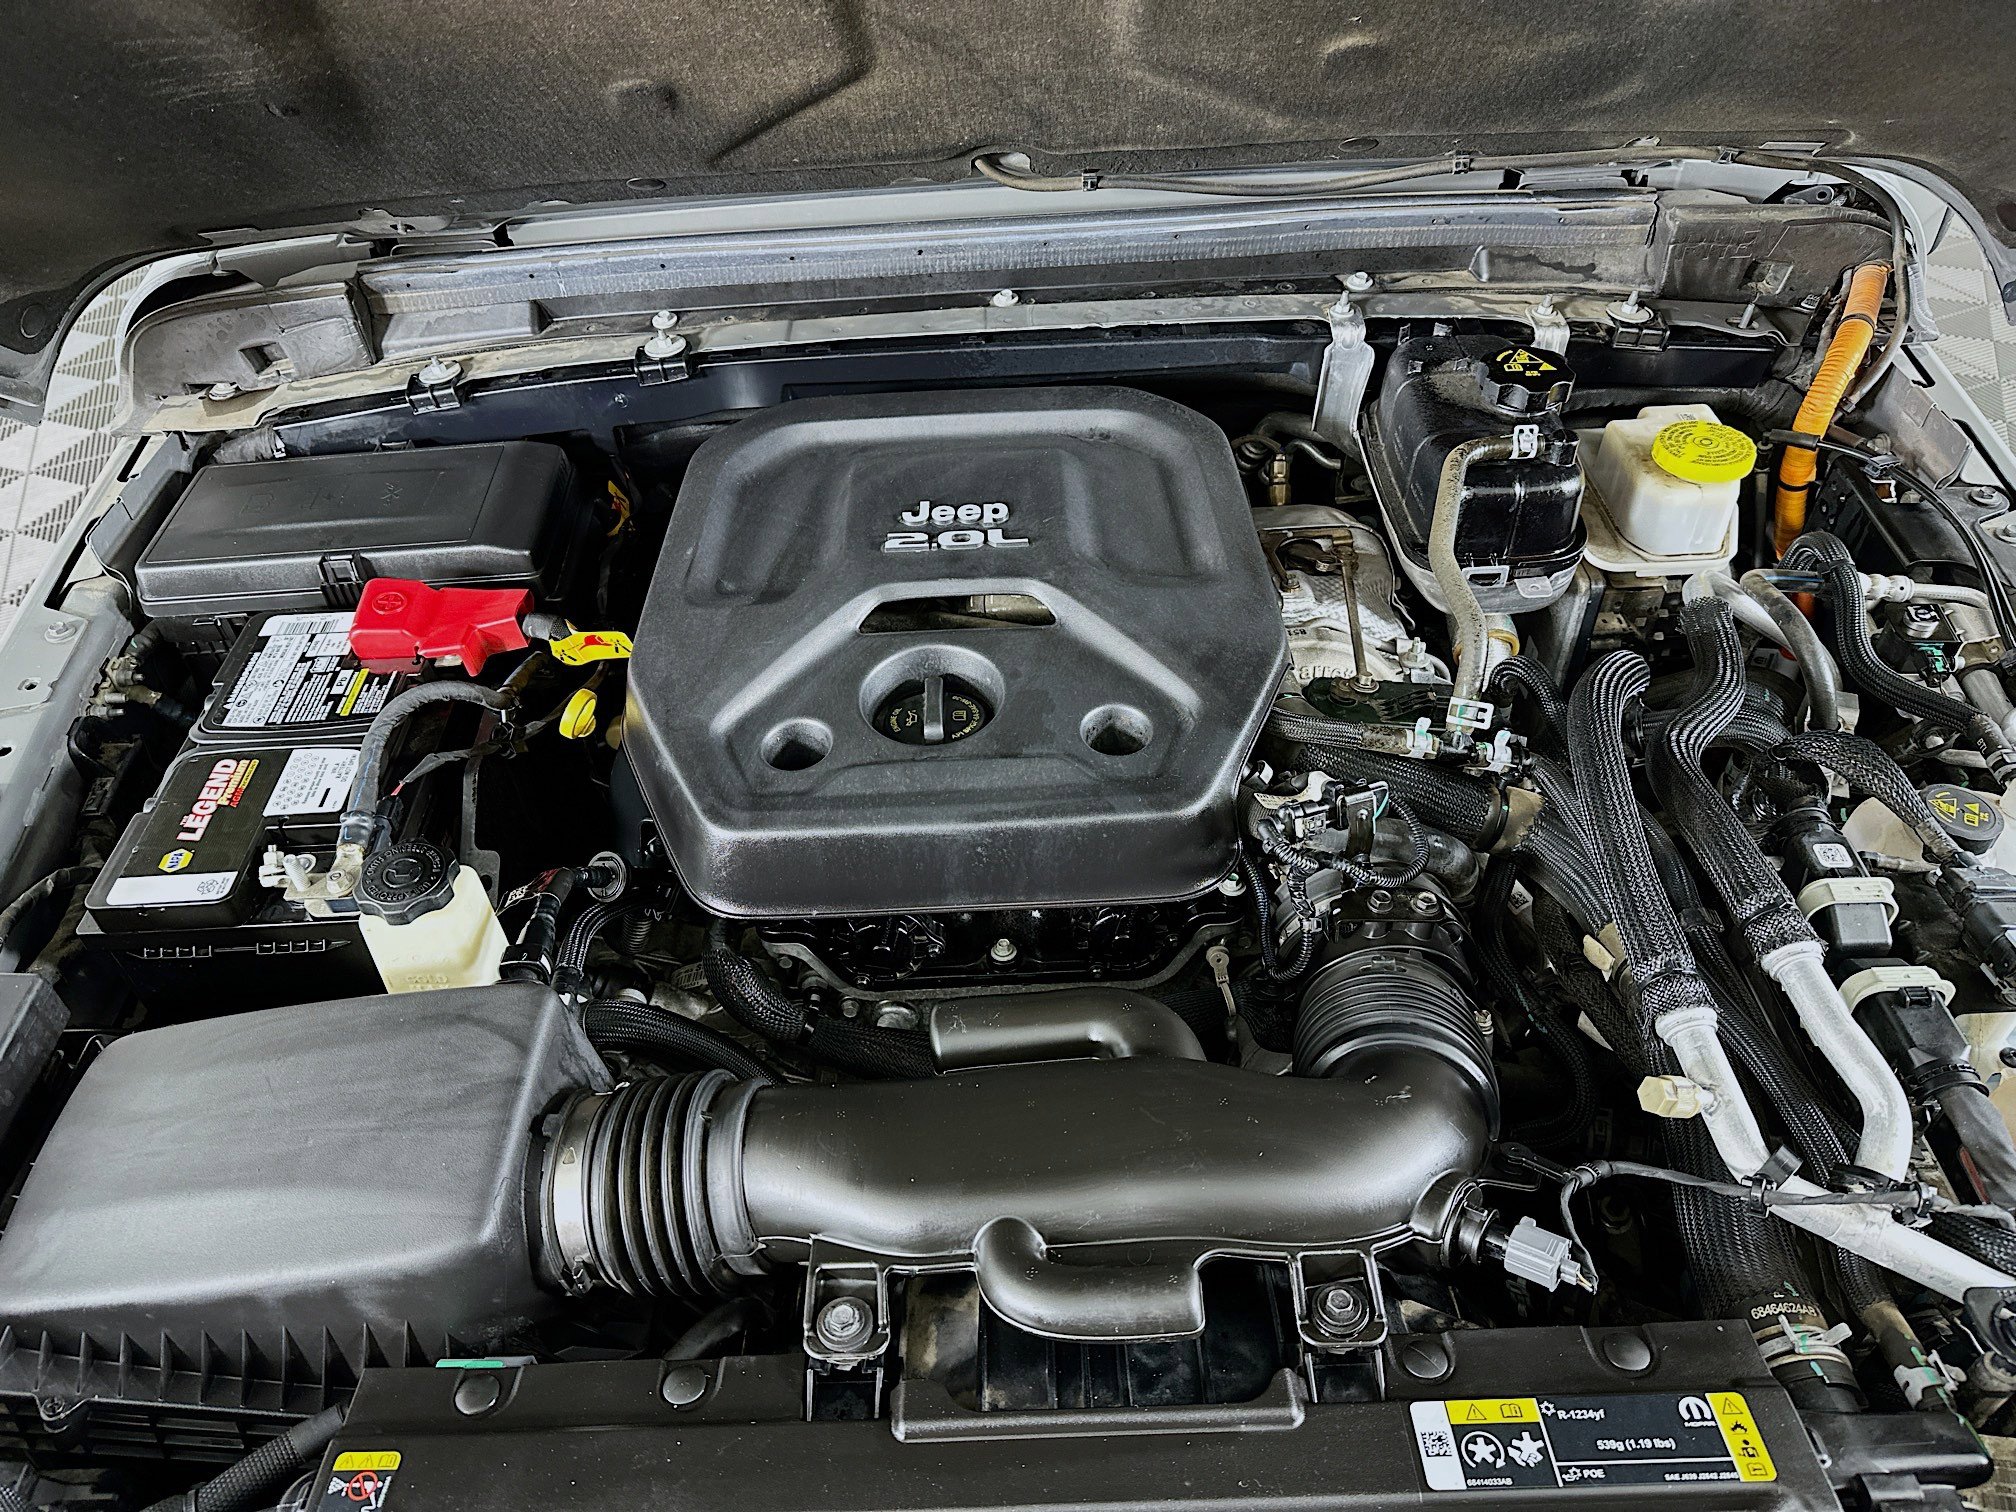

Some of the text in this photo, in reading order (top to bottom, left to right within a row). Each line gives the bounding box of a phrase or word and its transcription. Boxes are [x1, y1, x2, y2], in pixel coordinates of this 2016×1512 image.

[898, 500, 1009, 527] Jeep
[883, 529, 1030, 553] 2.0L
[336, 676, 348, 687] Pb
[893, 707, 903, 716] OIL
[1977, 738, 1987, 755] BTL
[218, 759, 251, 805] Premium
[177, 758, 238, 842] LEGEND
[166, 851, 183, 870] NAPA
[366, 857, 385, 876] FLUID
[1751, 1303, 1817, 1320] 68464624AB
[1556, 1408, 1606, 1421] R-1234yf
[1596, 1437, 1676, 1452] 539g (1.19 lbs)
[1583, 1468, 1605, 1479] POE
[1466, 1478, 1513, 1487] 68414033AB
